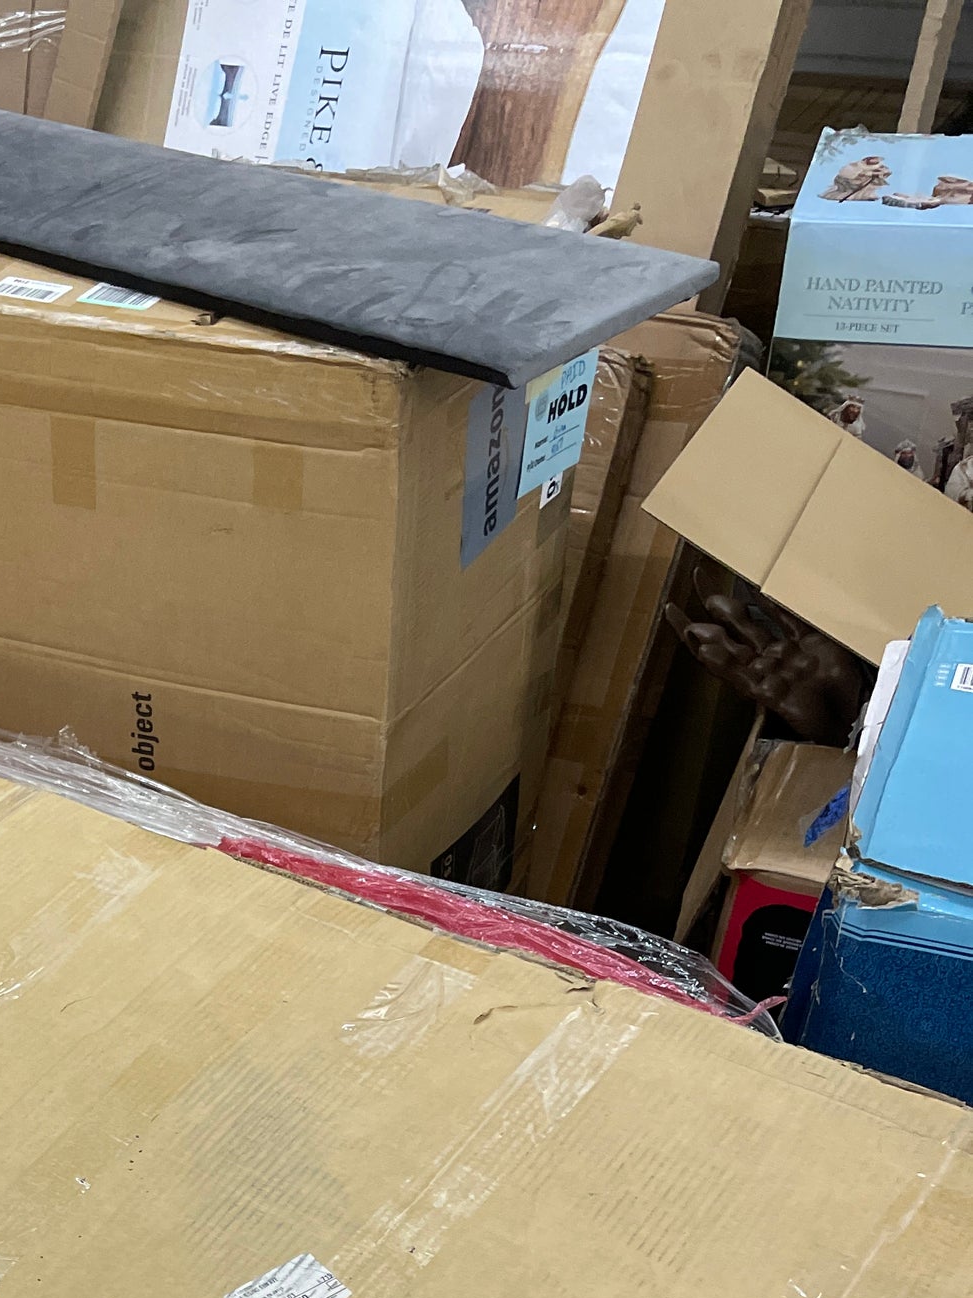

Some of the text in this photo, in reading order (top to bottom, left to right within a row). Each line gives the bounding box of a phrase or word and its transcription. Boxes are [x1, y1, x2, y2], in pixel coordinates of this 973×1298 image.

[282, 19, 293, 39] DE
[277, 45, 288, 66] LIT
[268, 74, 282, 106] LIVE
[309, 45, 350, 145] PIKE
[299, 65, 323, 152] DESIGNED
[259, 112, 274, 150] EDGE
[805, 276, 944, 295] HAND PAINTED
[827, 295, 915, 313] NATIVITY
[880, 323, 900, 334] SET
[546, 383, 588, 424] HOLD
[483, 385, 506, 537] amazon
[130, 691, 160, 772] object
